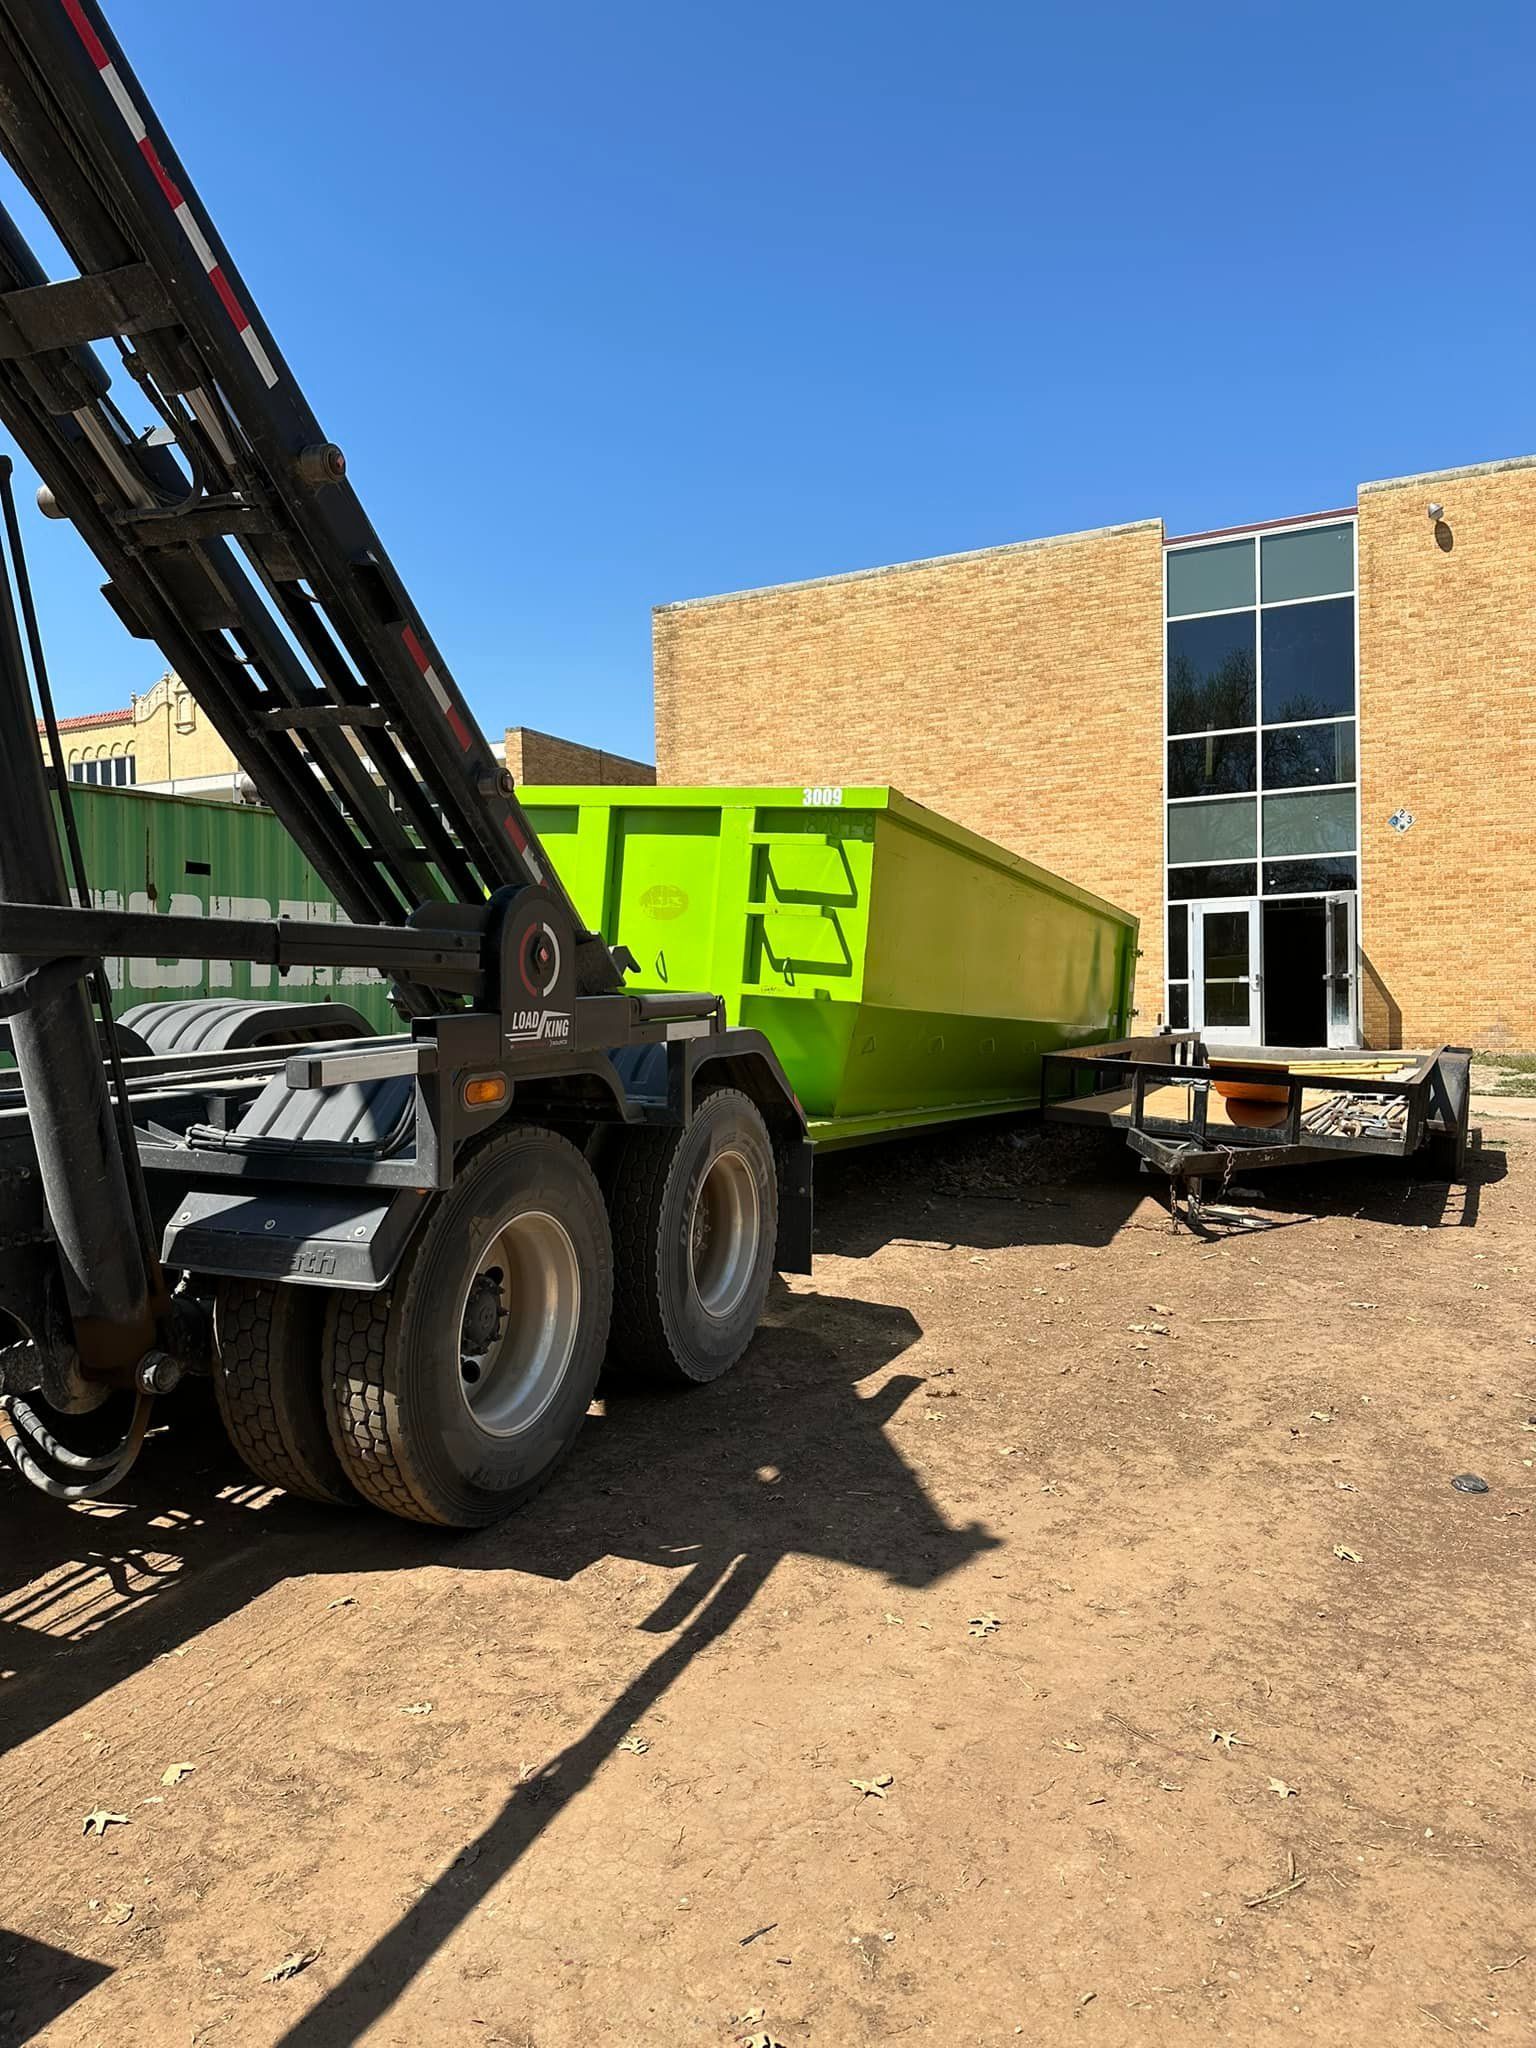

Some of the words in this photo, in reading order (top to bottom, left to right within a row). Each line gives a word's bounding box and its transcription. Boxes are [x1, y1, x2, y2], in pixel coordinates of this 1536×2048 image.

[803, 787, 843, 806] 3009
[1400, 809, 1405, 818] 2
[1407, 815, 1412, 824] 3
[512, 1011, 540, 1030] LOAD
[544, 1019, 569, 1038] KING
